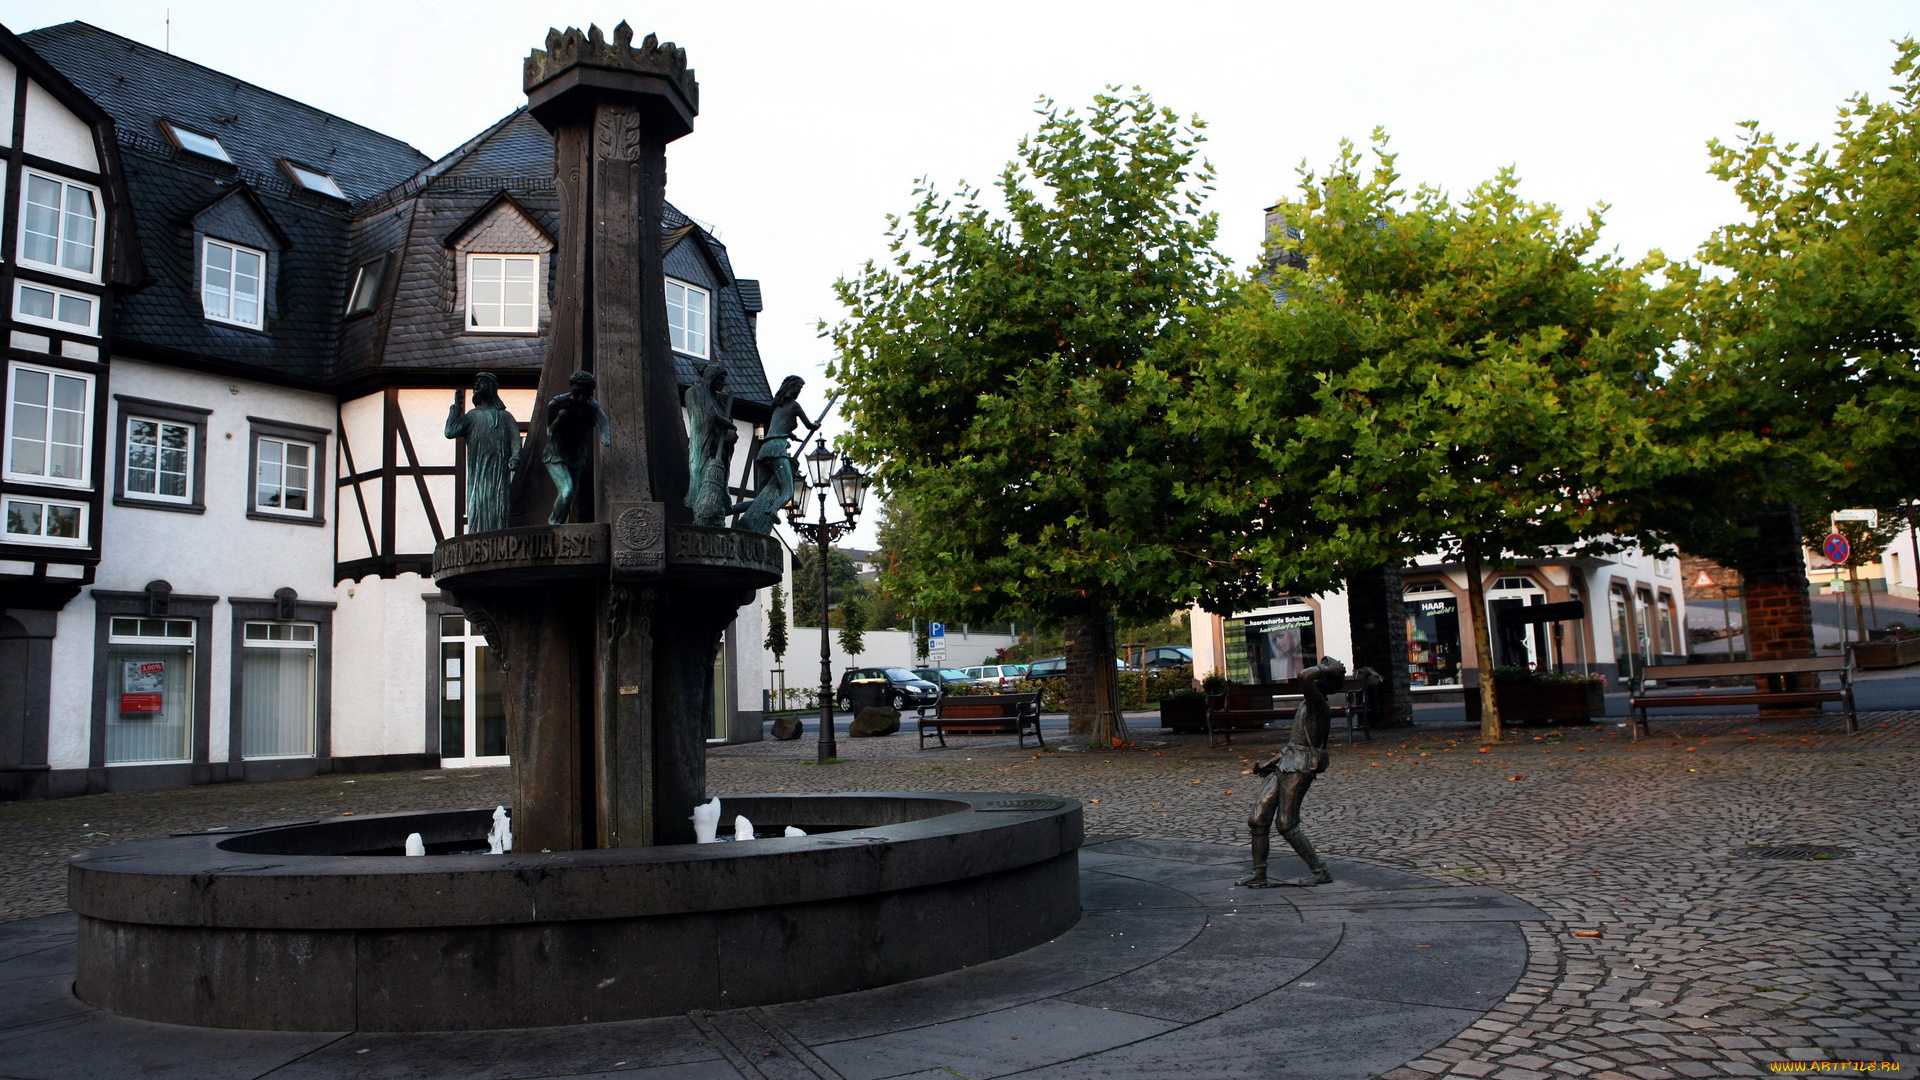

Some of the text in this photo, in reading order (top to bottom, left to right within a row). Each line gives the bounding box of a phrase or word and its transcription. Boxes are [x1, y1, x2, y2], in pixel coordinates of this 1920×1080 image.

[557, 533, 597, 558] EST
[1422, 602, 1444, 610] HAAR
[932, 622, 940, 636] P
